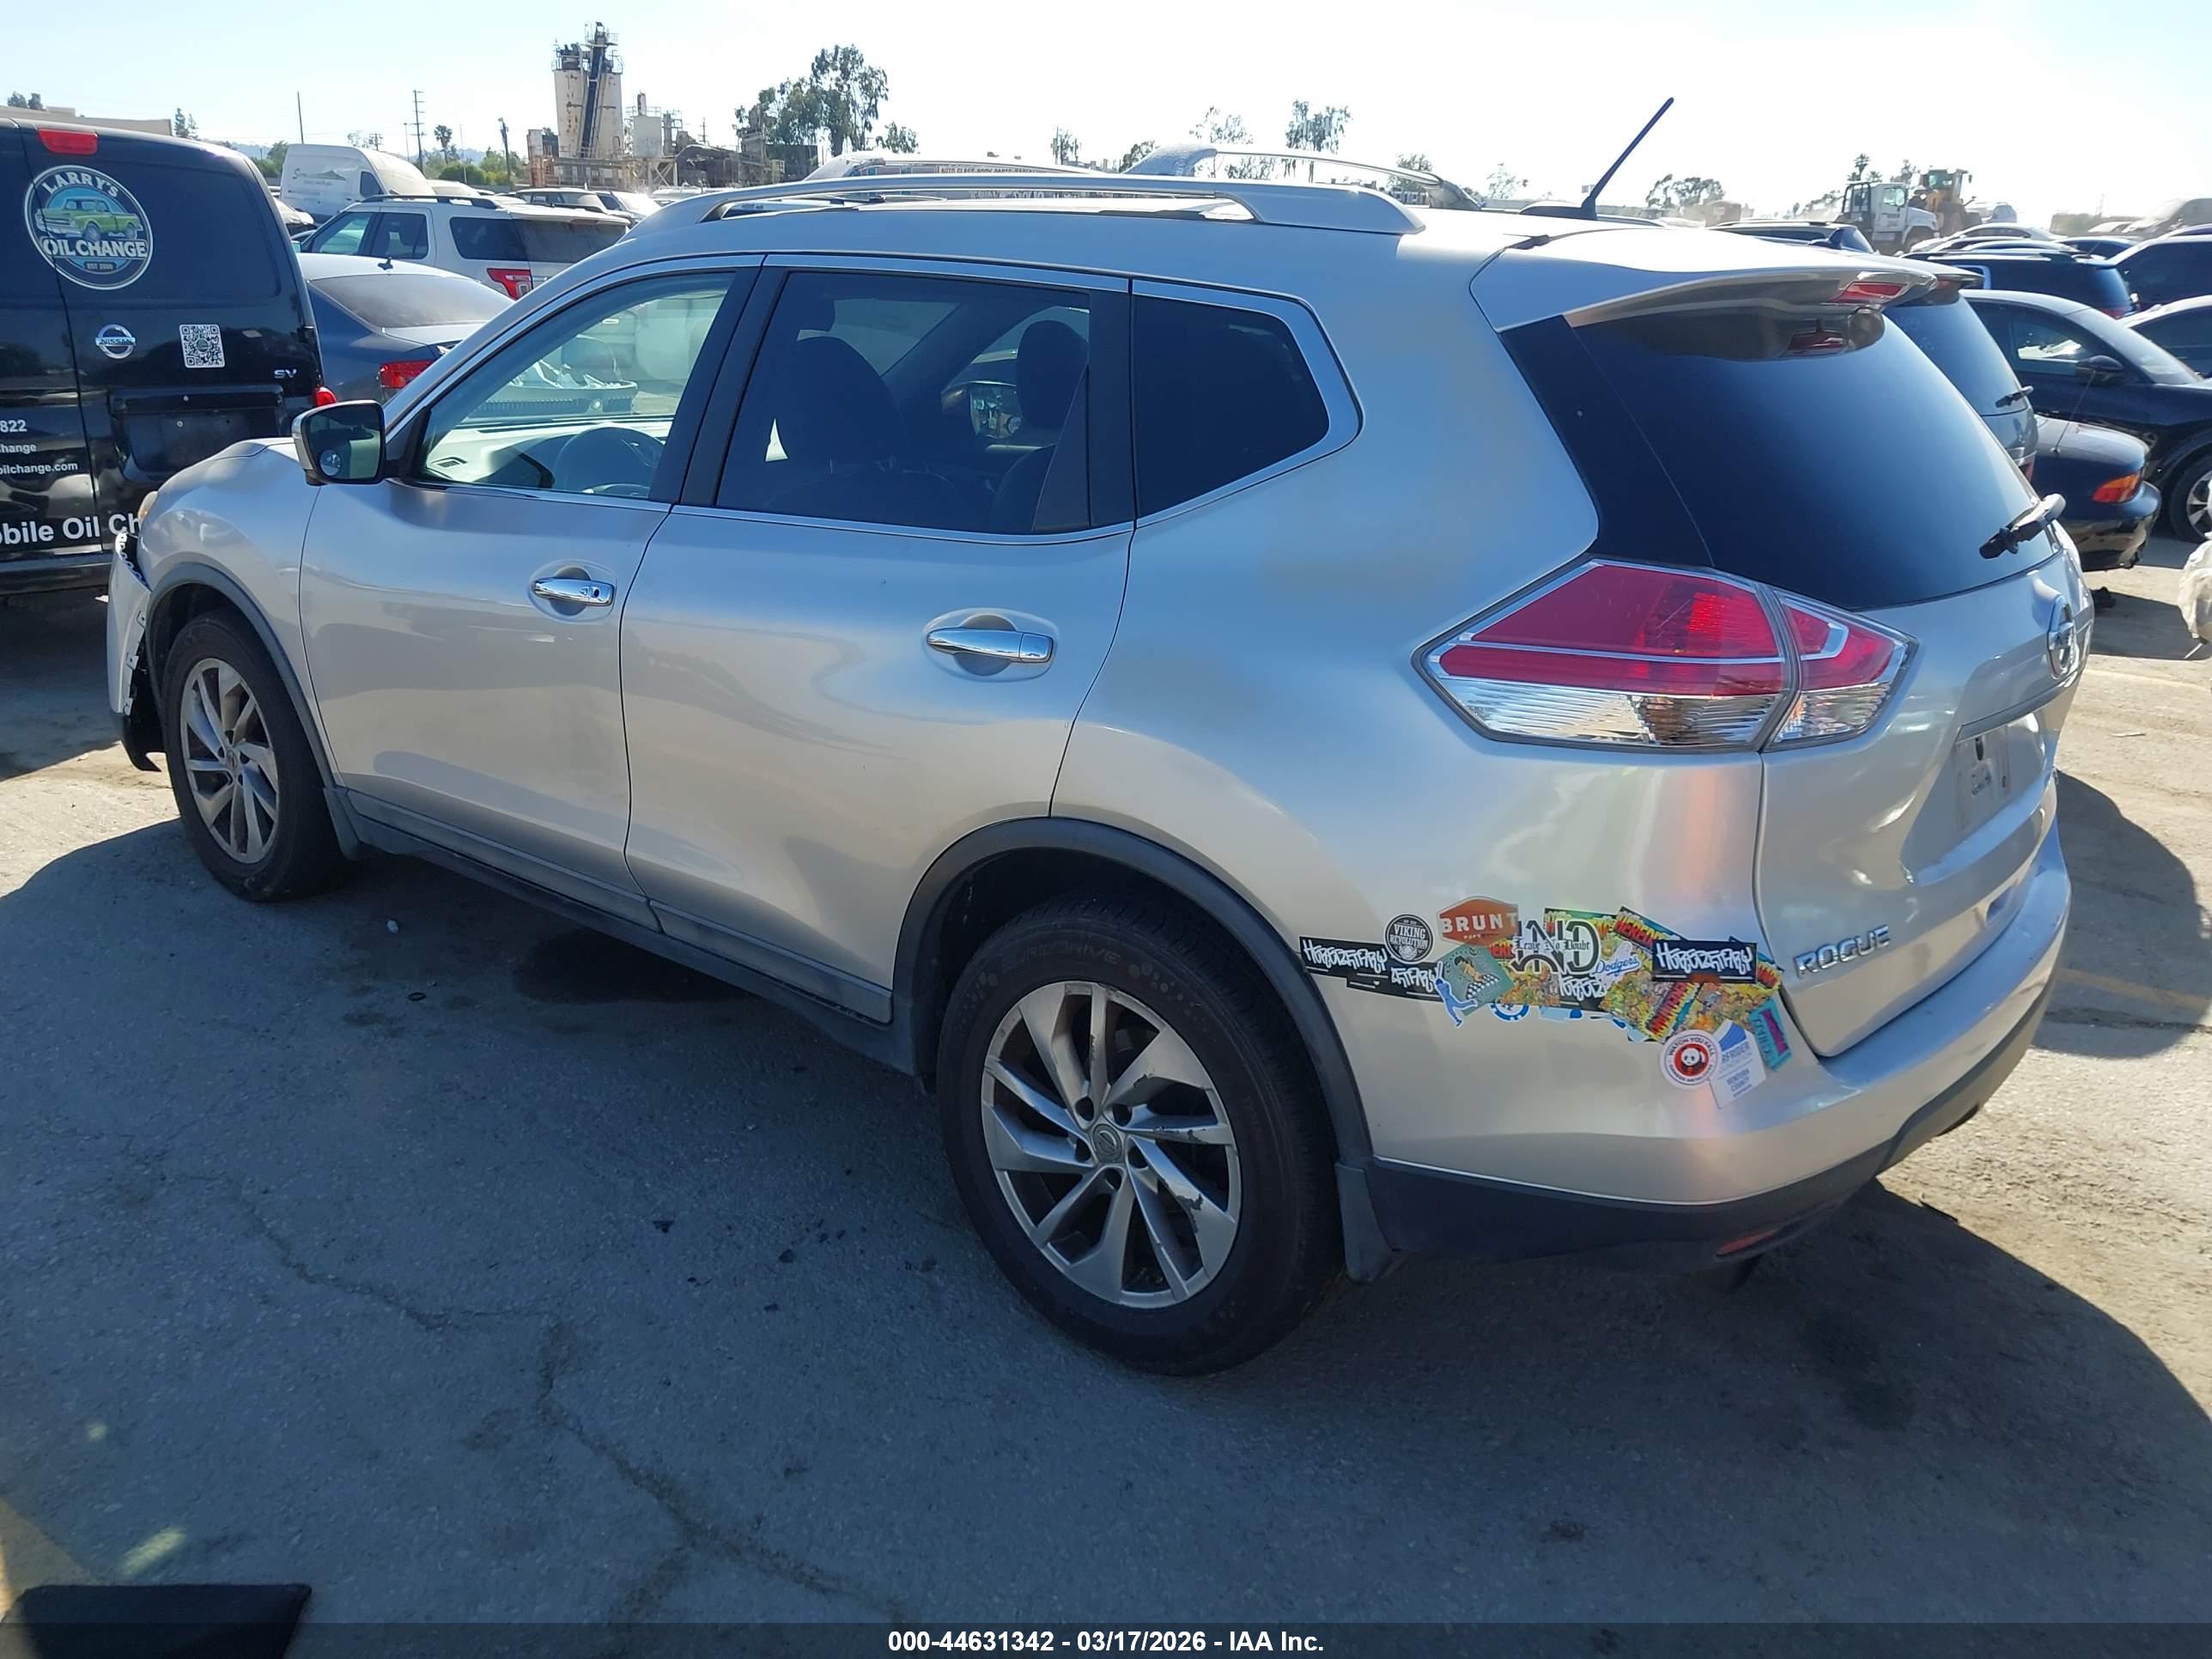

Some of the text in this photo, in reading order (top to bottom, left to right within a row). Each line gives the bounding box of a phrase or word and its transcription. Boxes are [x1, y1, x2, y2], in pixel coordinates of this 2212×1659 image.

[42, 171, 118, 198] LARRY'S
[43, 239, 148, 257] OIL CHANGE
[98, 337, 135, 346] NISSAN
[274, 369, 297, 379] SV
[0, 443, 37, 454] hange
[0, 520, 54, 544] bile
[63, 516, 100, 539] Oil
[1394, 924, 1426, 939] VIKING
[1440, 913, 1517, 933] BRUNT
[1389, 934, 1430, 951] REVOLUTION
[1513, 936, 1590, 951] Leave No Doubt
[1793, 924, 1892, 979] ROGUE
[1595, 954, 1639, 975] Dodgers
